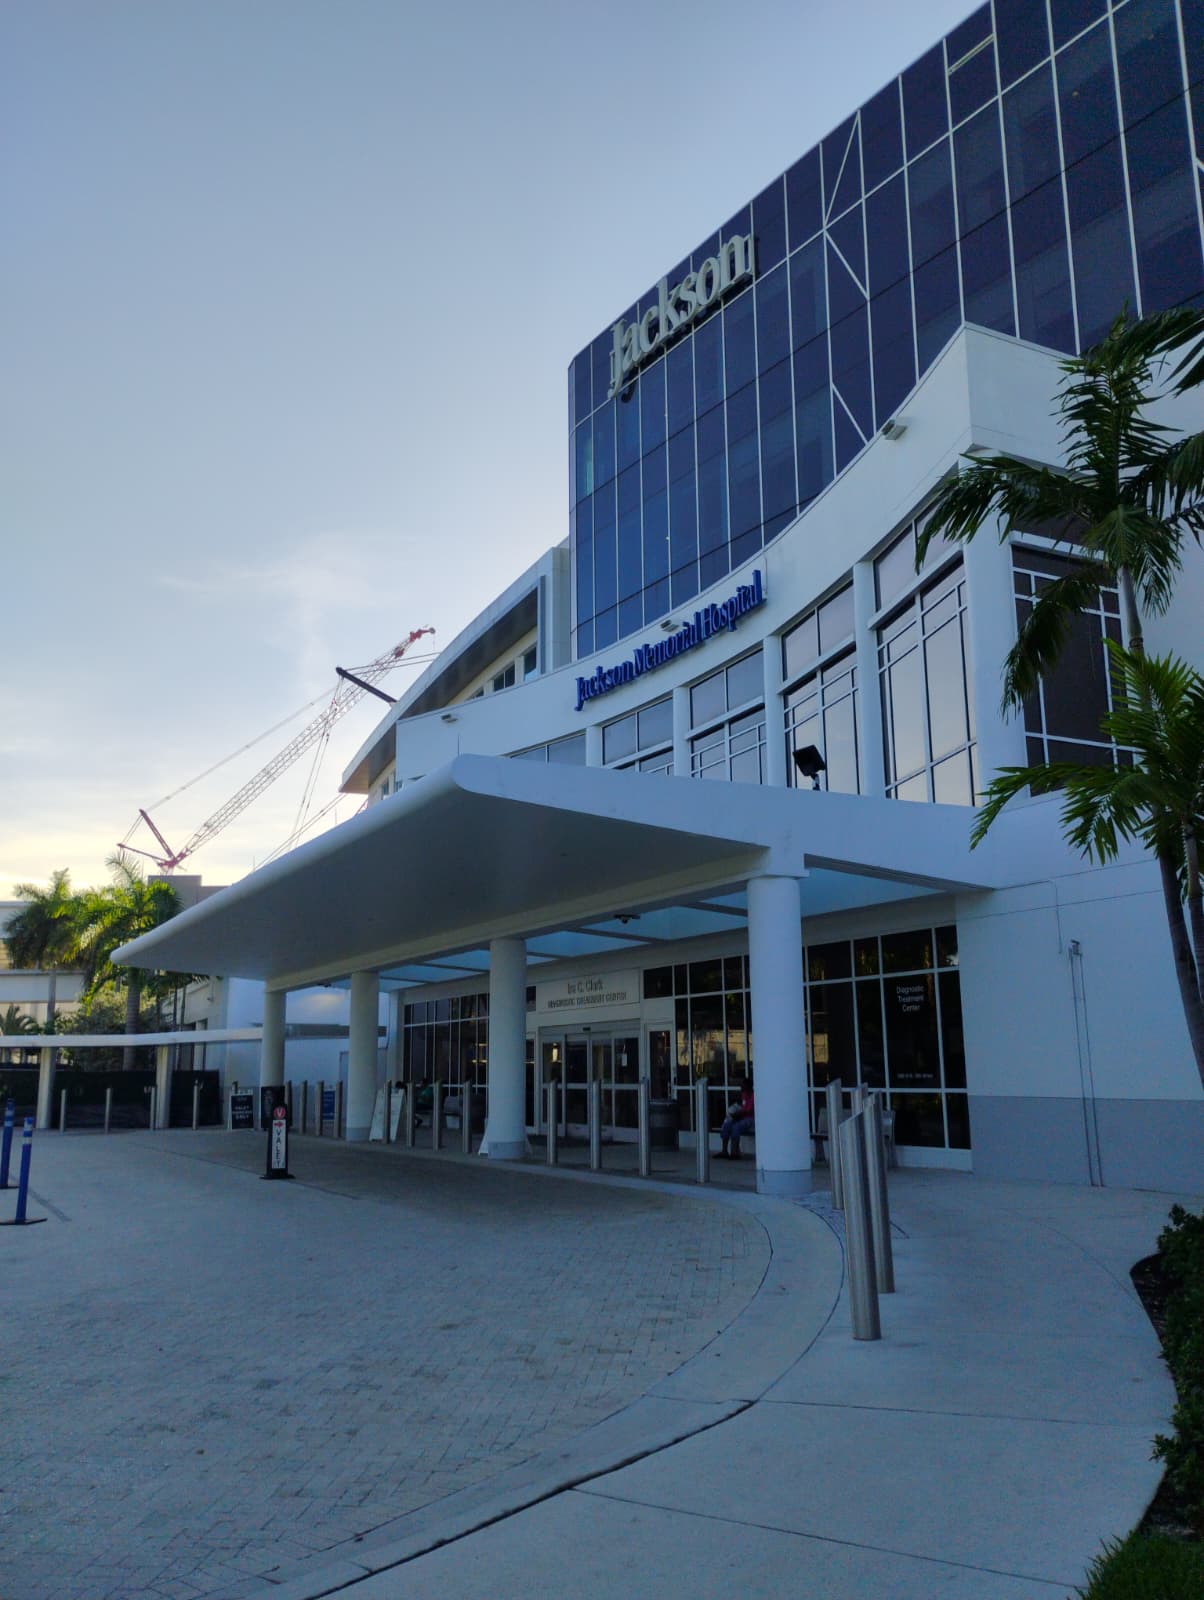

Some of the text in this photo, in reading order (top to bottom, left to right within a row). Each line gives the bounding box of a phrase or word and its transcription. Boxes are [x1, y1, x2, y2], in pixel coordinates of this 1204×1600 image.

[608, 235, 754, 399] Jackson
[575, 570, 763, 711] Jackson Memorial Hospital
